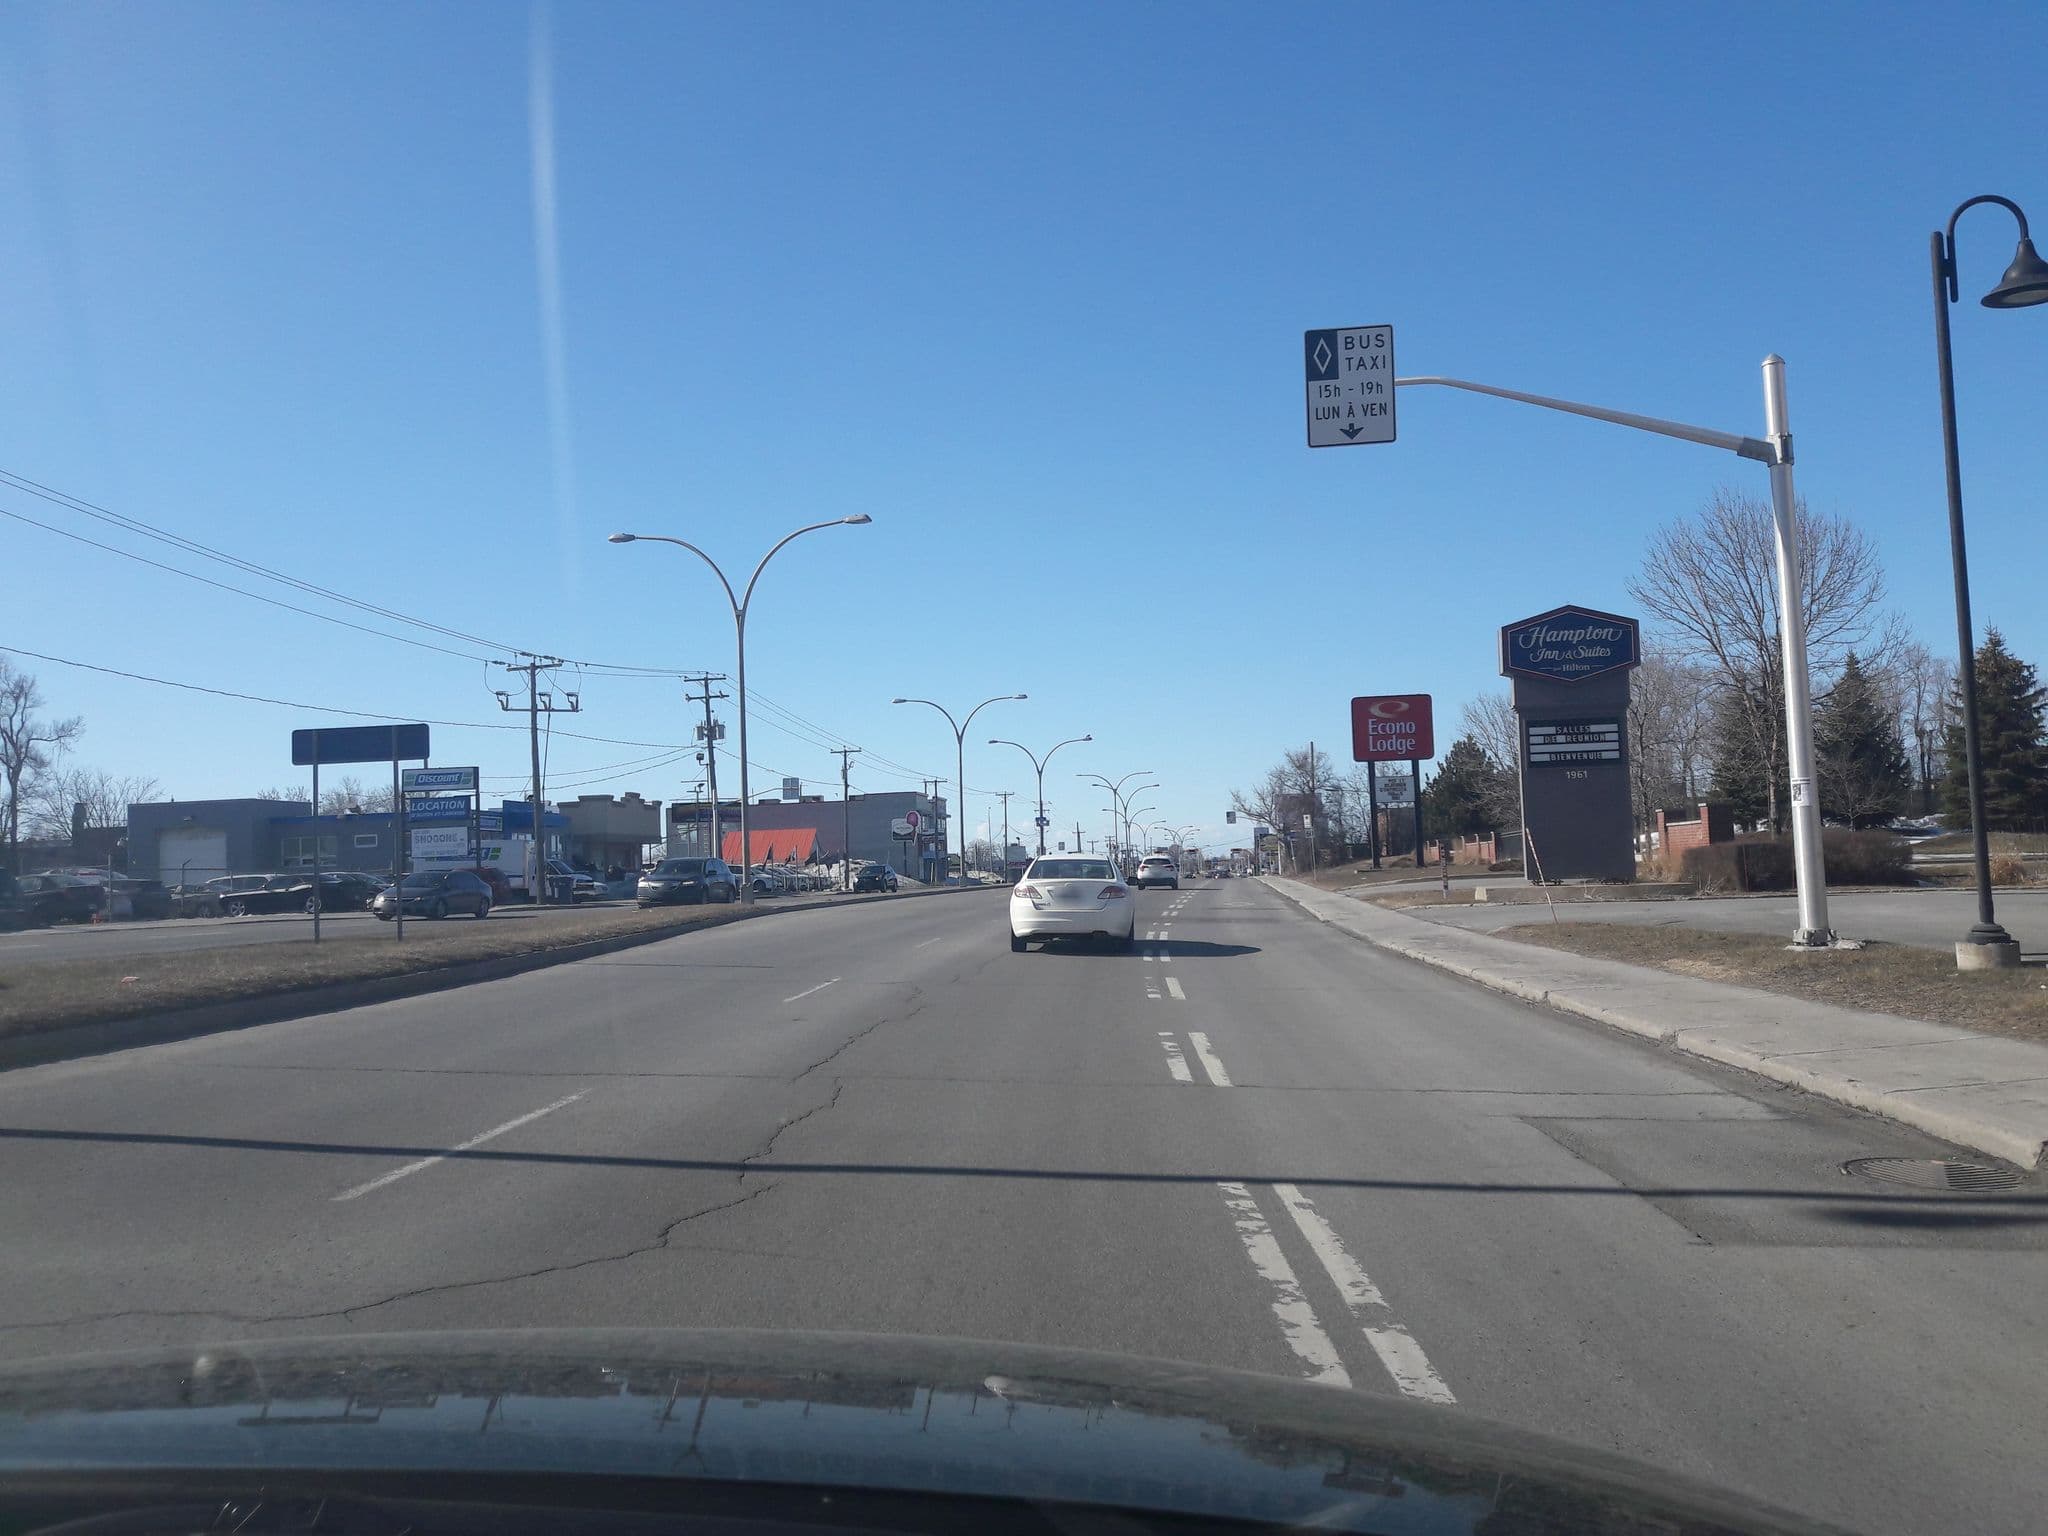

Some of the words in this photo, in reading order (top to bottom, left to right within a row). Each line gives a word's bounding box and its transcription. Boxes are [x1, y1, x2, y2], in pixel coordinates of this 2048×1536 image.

[1344, 333, 1385, 350] BUS
[1345, 355, 1386, 371] TAXI
[1318, 384, 1341, 398] 15h
[1360, 381, 1383, 395] 19h
[1315, 405, 1340, 420] LUN
[1361, 402, 1388, 416] VEN
[1519, 625, 1622, 649] Hampton
[1530, 648, 1565, 662] Inn
[1564, 651, 1573, 660] &
[1573, 645, 1612, 660] Suites
[1562, 663, 1590, 672] Hilton
[1368, 718, 1416, 735] Econo
[1556, 725, 1590, 734] SALLES
[1369, 736, 1416, 755] Lodge
[1566, 770, 1588, 779] 1961
[411, 800, 465, 811] LOCATION
